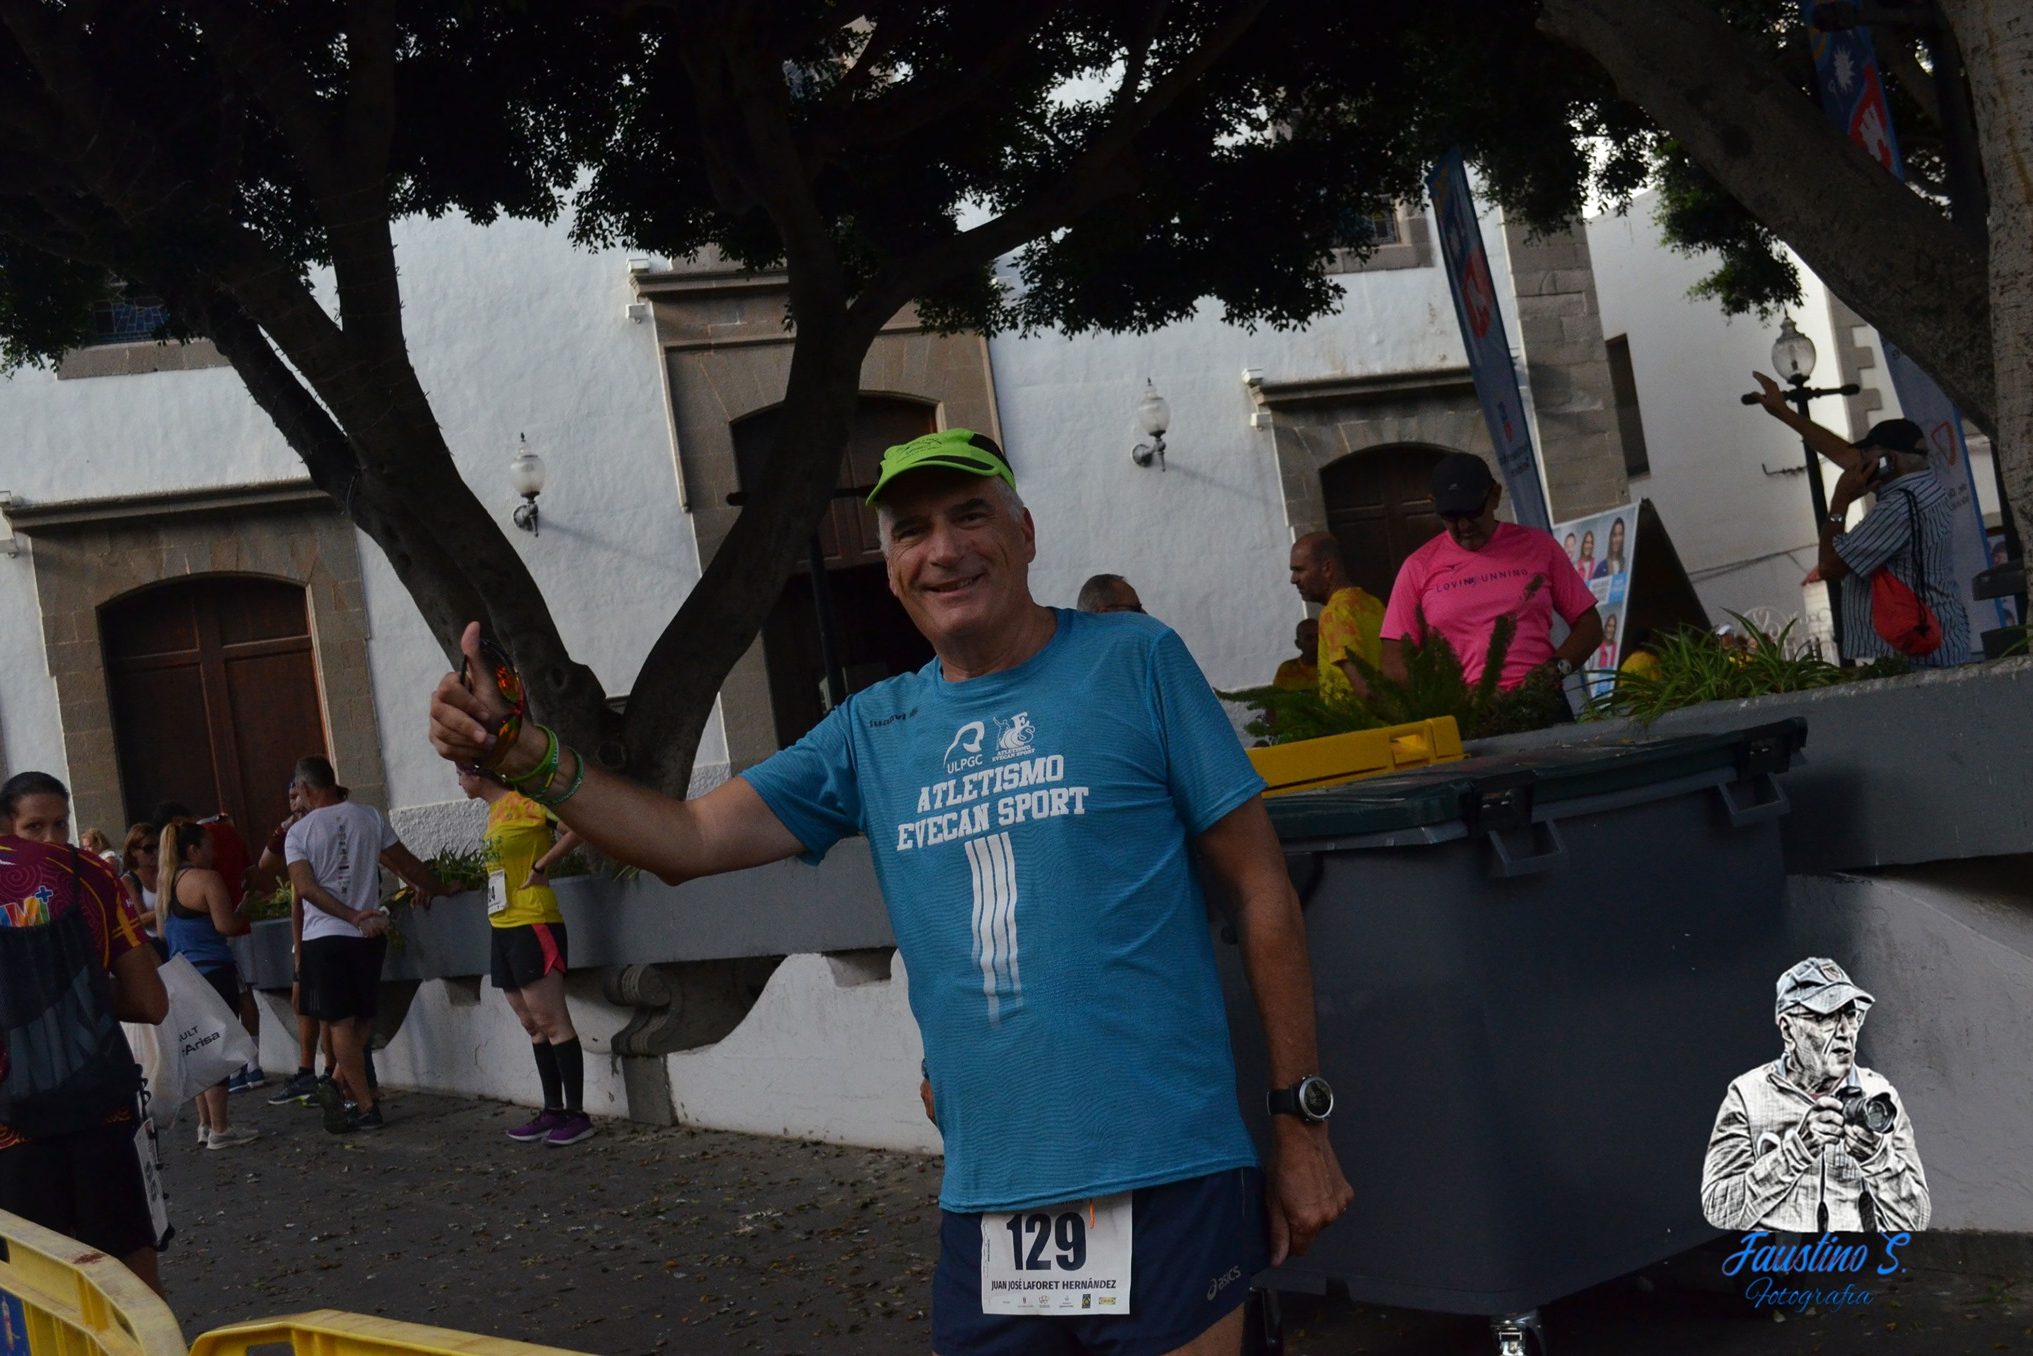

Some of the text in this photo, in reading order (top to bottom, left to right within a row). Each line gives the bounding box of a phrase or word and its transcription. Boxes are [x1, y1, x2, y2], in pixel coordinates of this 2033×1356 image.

[947, 754, 983, 774] ULPGC
[917, 754, 1064, 813] ATLETISMO
[897, 787, 1089, 851] EVECAN SPORT
[179, 1025, 198, 1042] ULT
[182, 1032, 220, 1055] Arisa
[1006, 1211, 1087, 1271] 129
[991, 1278, 1117, 1291] JUAN JOSÉ LAFORET HERNÁNDEZ
